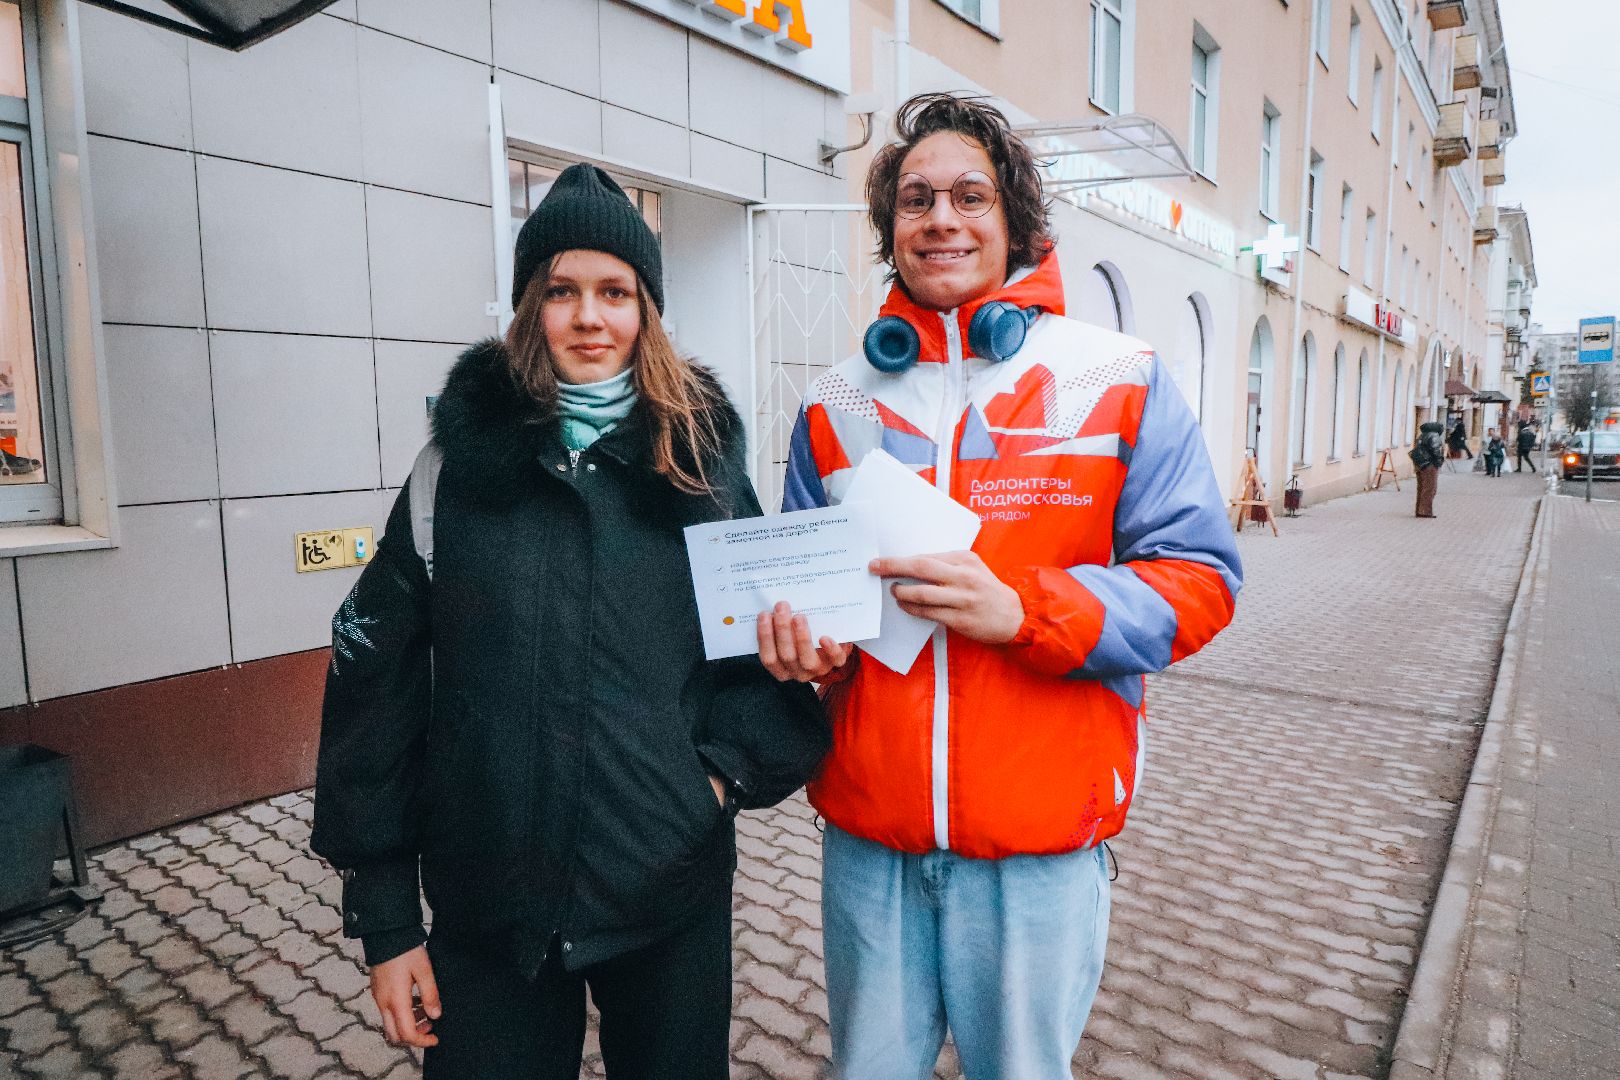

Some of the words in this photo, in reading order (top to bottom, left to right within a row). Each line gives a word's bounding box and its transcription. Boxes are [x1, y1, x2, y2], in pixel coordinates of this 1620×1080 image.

[969, 494, 1093, 508] ПОДМОСКОВЬЯ
[991, 511, 1031, 522] РЯДОМ
[725, 528, 769, 539] Сделайте
[771, 523, 807, 533] одежду
[785, 528, 818, 537] дороге
